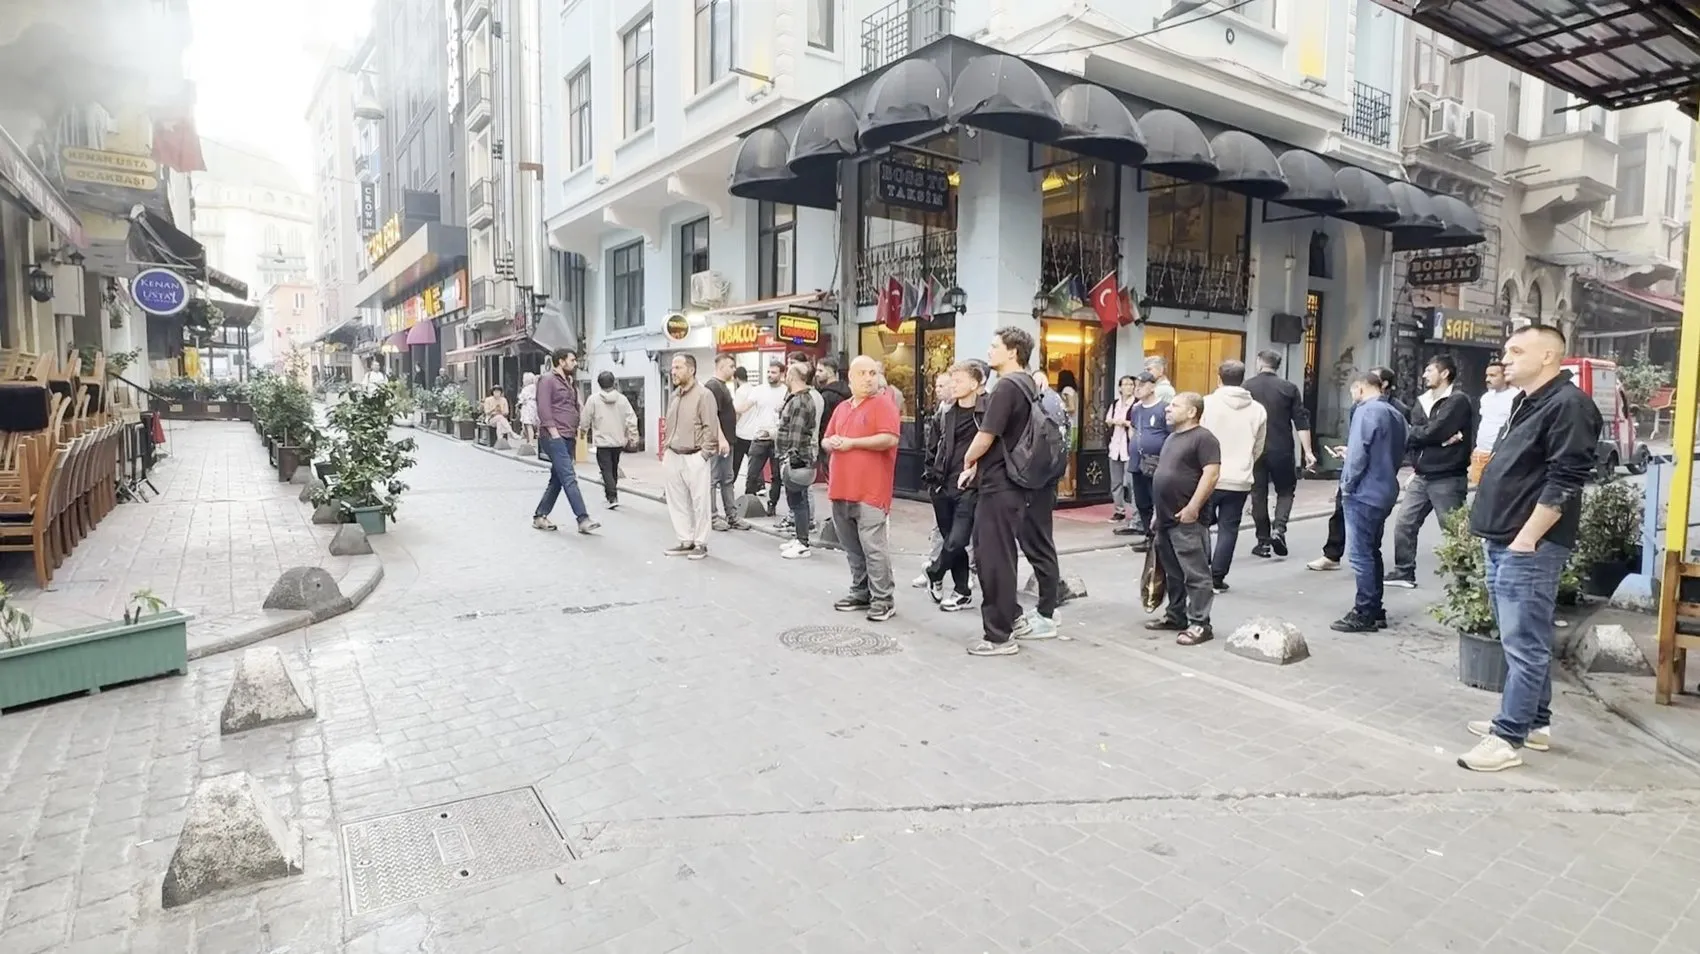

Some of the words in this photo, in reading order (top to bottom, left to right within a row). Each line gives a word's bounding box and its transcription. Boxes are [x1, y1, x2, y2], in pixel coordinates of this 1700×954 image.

[68, 151, 113, 164] KENAN
[116, 157, 148, 168] USTA
[881, 164, 924, 187] BOSS
[364, 187, 373, 227] CROWN
[1455, 256, 1477, 268] TO
[141, 279, 180, 289] KENAN
[716, 323, 758, 345] TOBACCO
